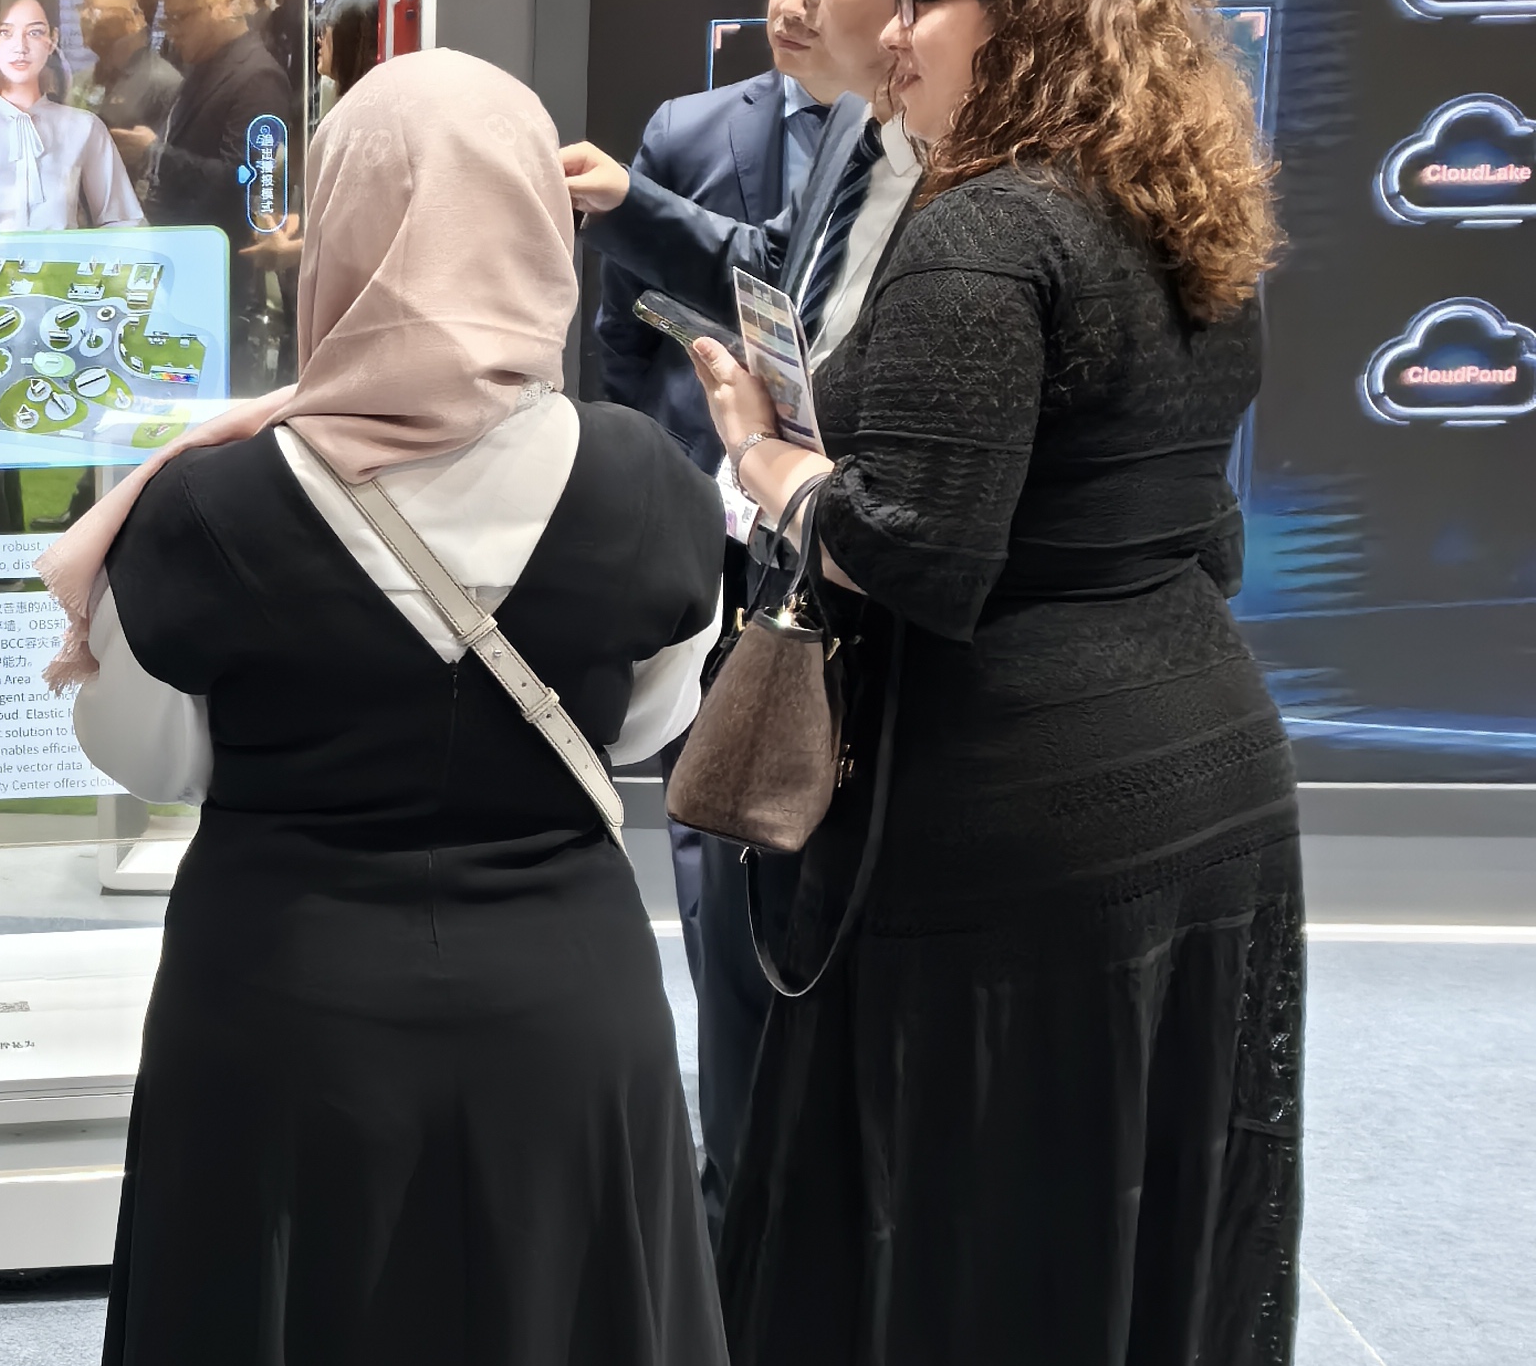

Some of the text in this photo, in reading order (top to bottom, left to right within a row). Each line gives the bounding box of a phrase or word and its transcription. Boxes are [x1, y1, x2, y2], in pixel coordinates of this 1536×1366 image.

[1425, 163, 1532, 182] CloudLake
[1405, 365, 1517, 383] CloudPond
[2, 541, 44, 554] robust,
[4, 674, 31, 684] Area
[28, 691, 50, 702] and
[26, 707, 64, 719] Elastic
[5, 726, 53, 738] solution
[56, 726, 68, 736] to
[16, 762, 53, 773] vector
[12, 779, 50, 790] Center
[53, 777, 87, 789] offers
